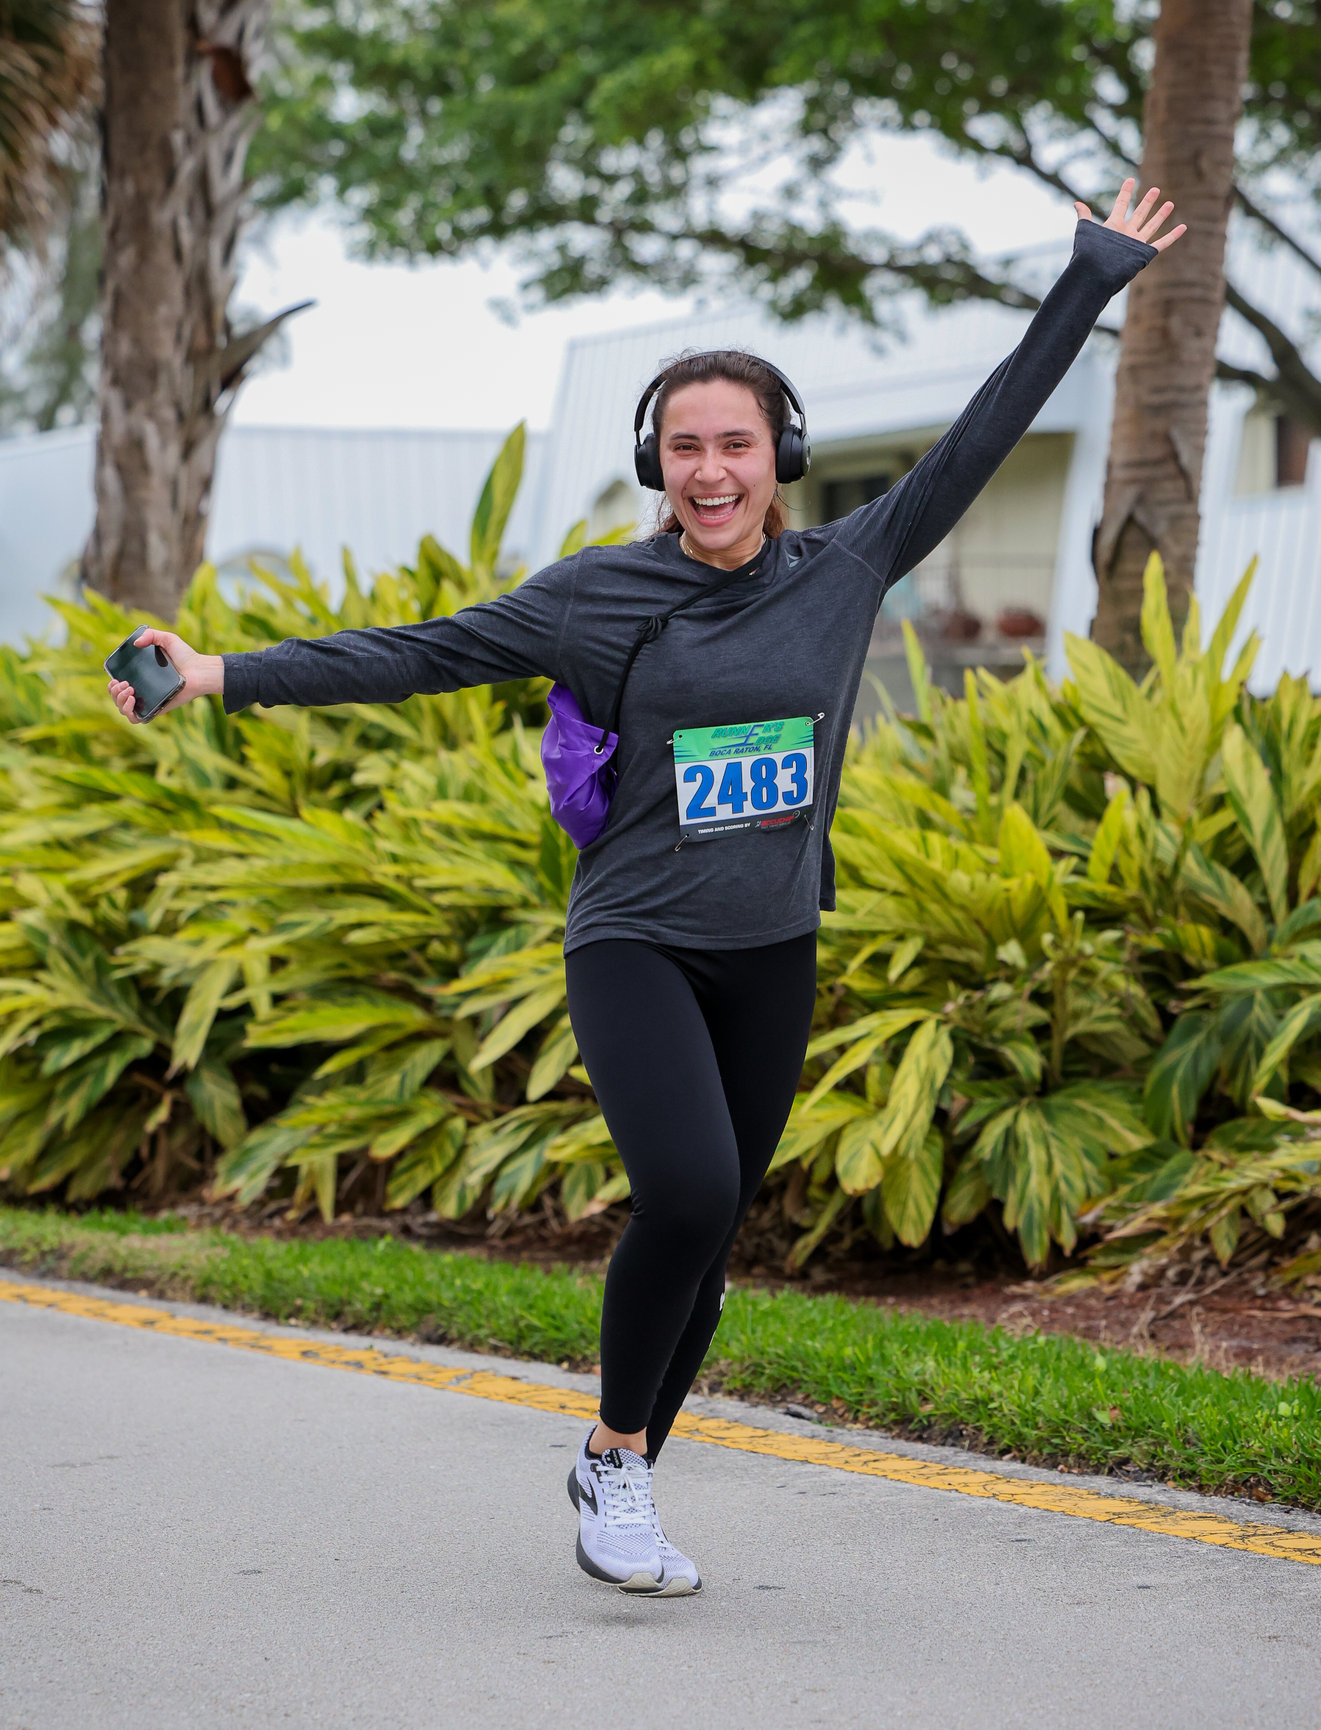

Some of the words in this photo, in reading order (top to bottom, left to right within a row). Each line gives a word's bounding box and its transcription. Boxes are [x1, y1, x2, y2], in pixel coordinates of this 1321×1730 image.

[709, 748, 732, 757] BOCA
[763, 743, 773, 751] FL
[683, 752, 808, 820] 2483
[698, 827, 714, 835] TIMING
